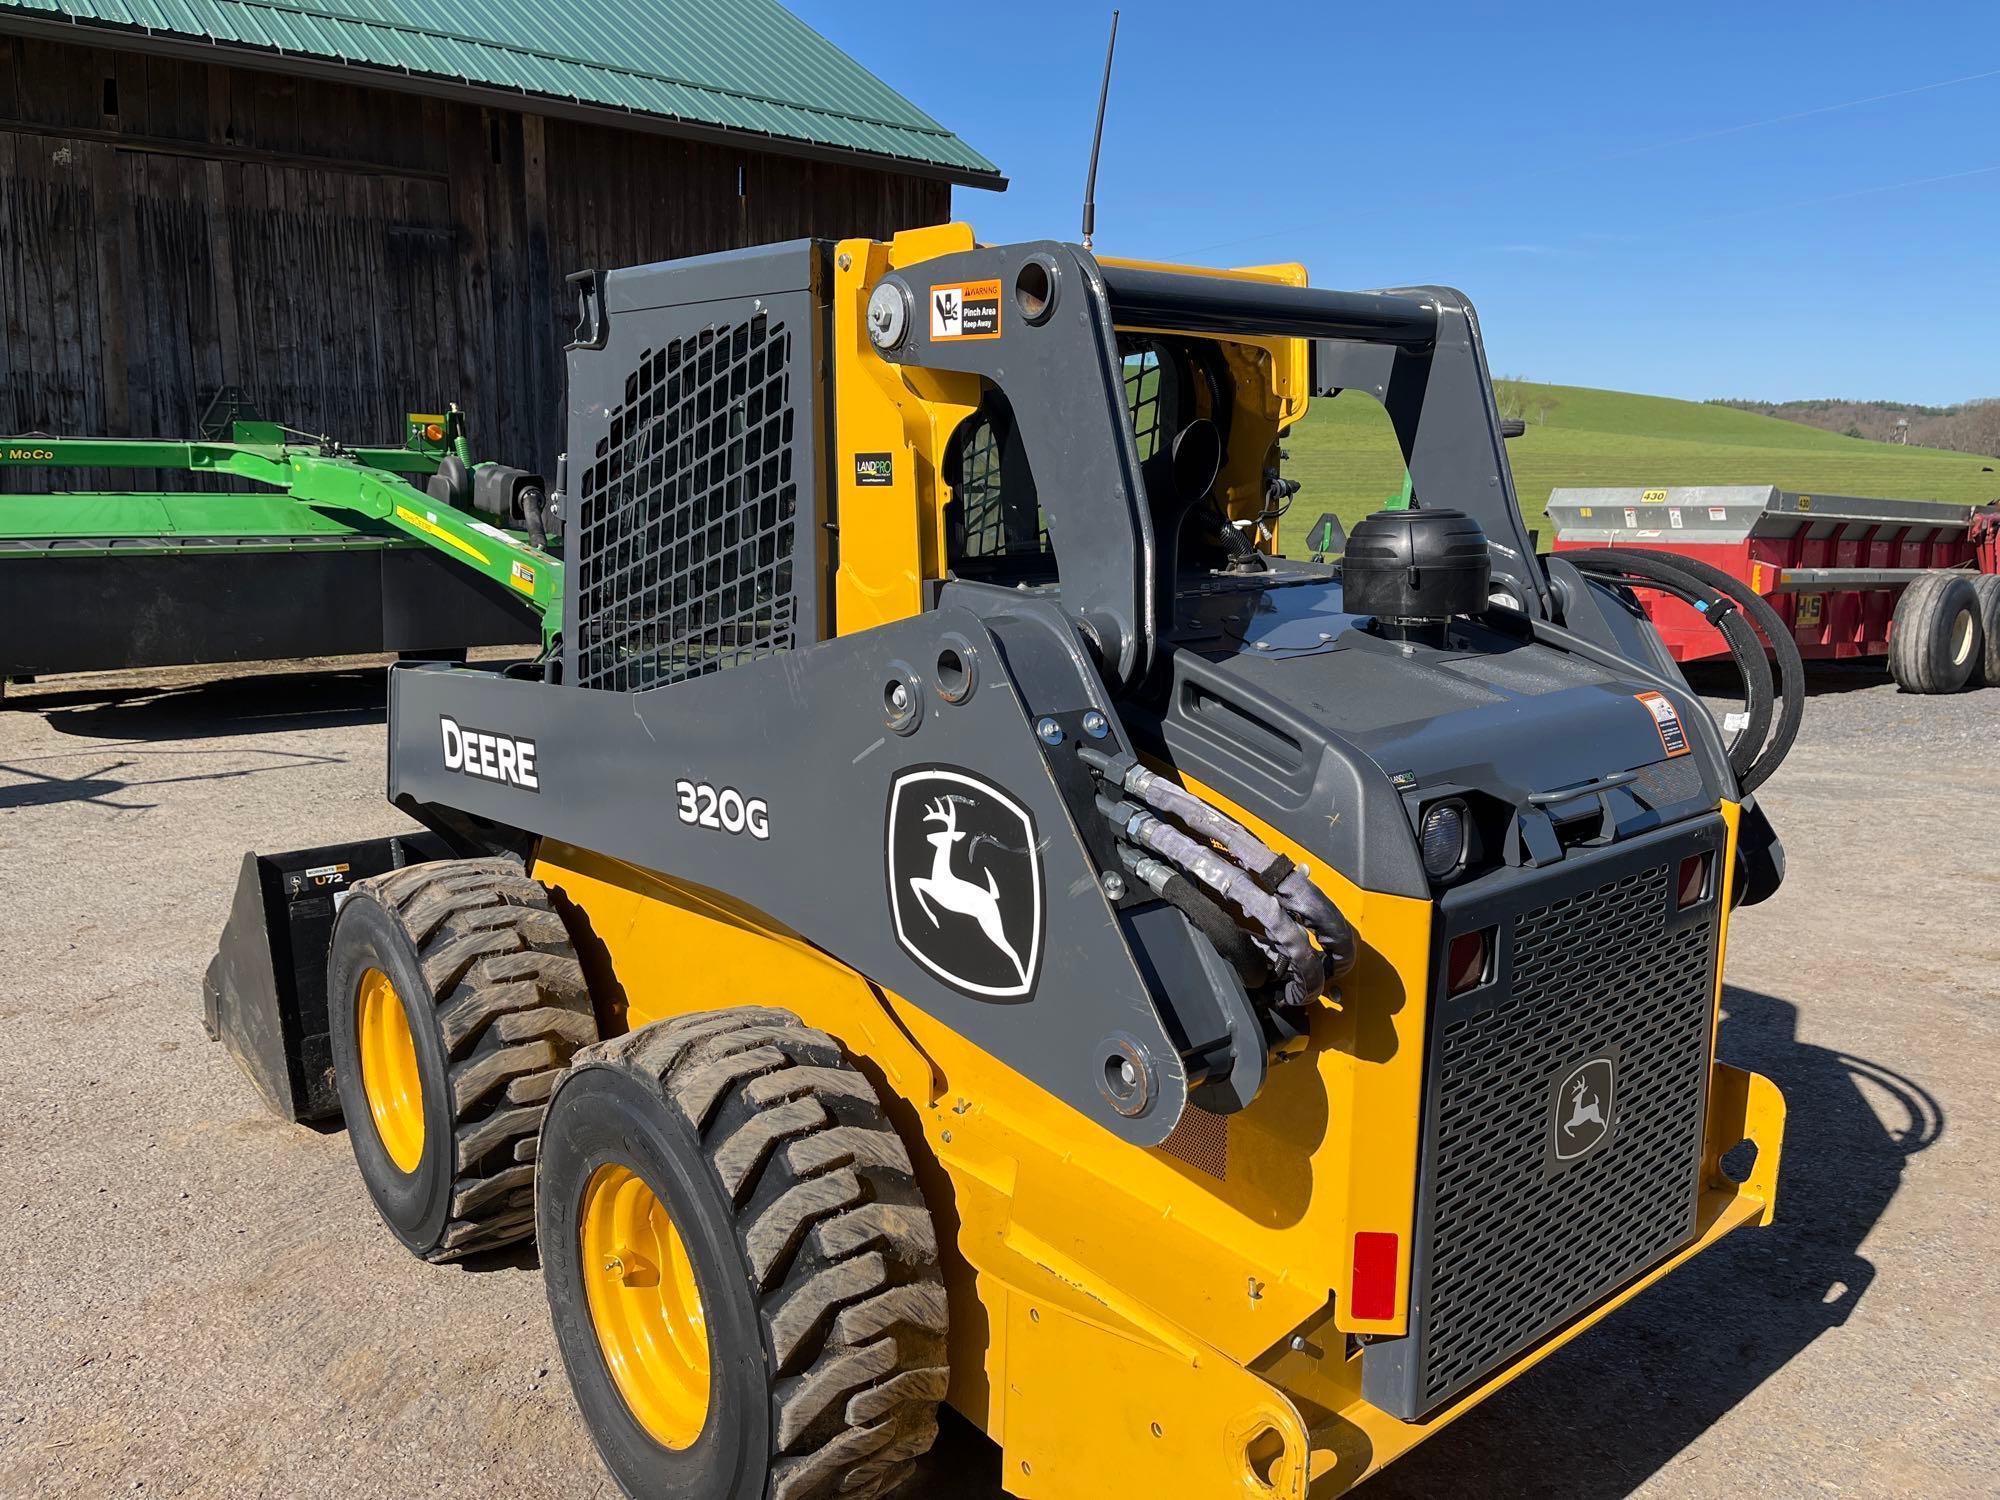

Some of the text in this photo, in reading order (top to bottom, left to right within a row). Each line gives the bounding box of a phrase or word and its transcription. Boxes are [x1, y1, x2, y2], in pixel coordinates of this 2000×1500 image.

[970, 286, 998, 295] WARNING
[963, 306, 997, 317] Pinch Area
[963, 320, 992, 329] Keep Away
[9, 449, 54, 459] MoCo
[857, 460, 891, 474] LANDPRO
[1643, 492, 1665, 501] 430
[1800, 498, 1810, 508] 430
[441, 717, 539, 790] DEERE
[676, 780, 769, 839] 320G
[315, 873, 343, 885] U72
